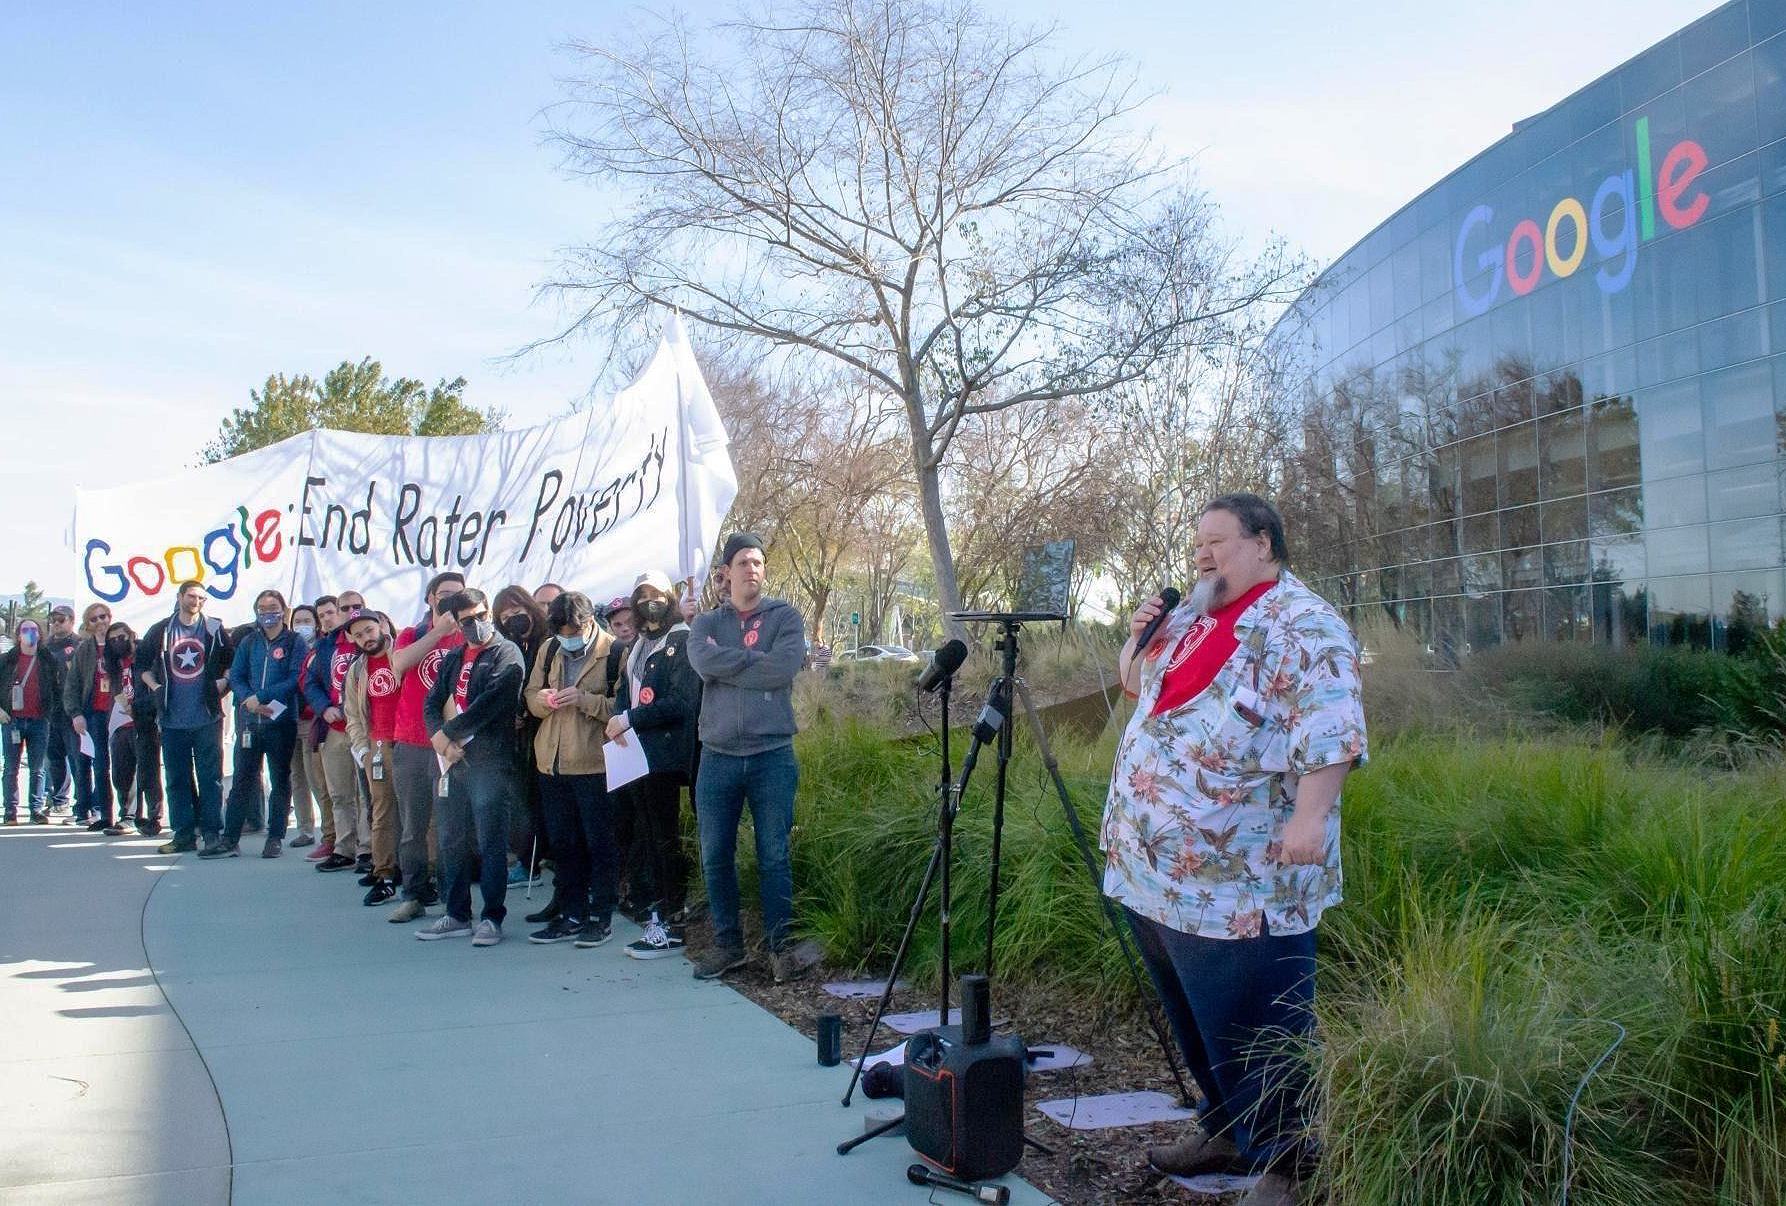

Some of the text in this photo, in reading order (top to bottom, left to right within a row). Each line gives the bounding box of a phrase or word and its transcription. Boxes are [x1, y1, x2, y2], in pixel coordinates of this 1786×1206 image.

[1454, 116, 1711, 316] Google
[299, 476, 376, 554] End
[393, 483, 506, 568] Rater
[519, 426, 668, 563] Poverty
